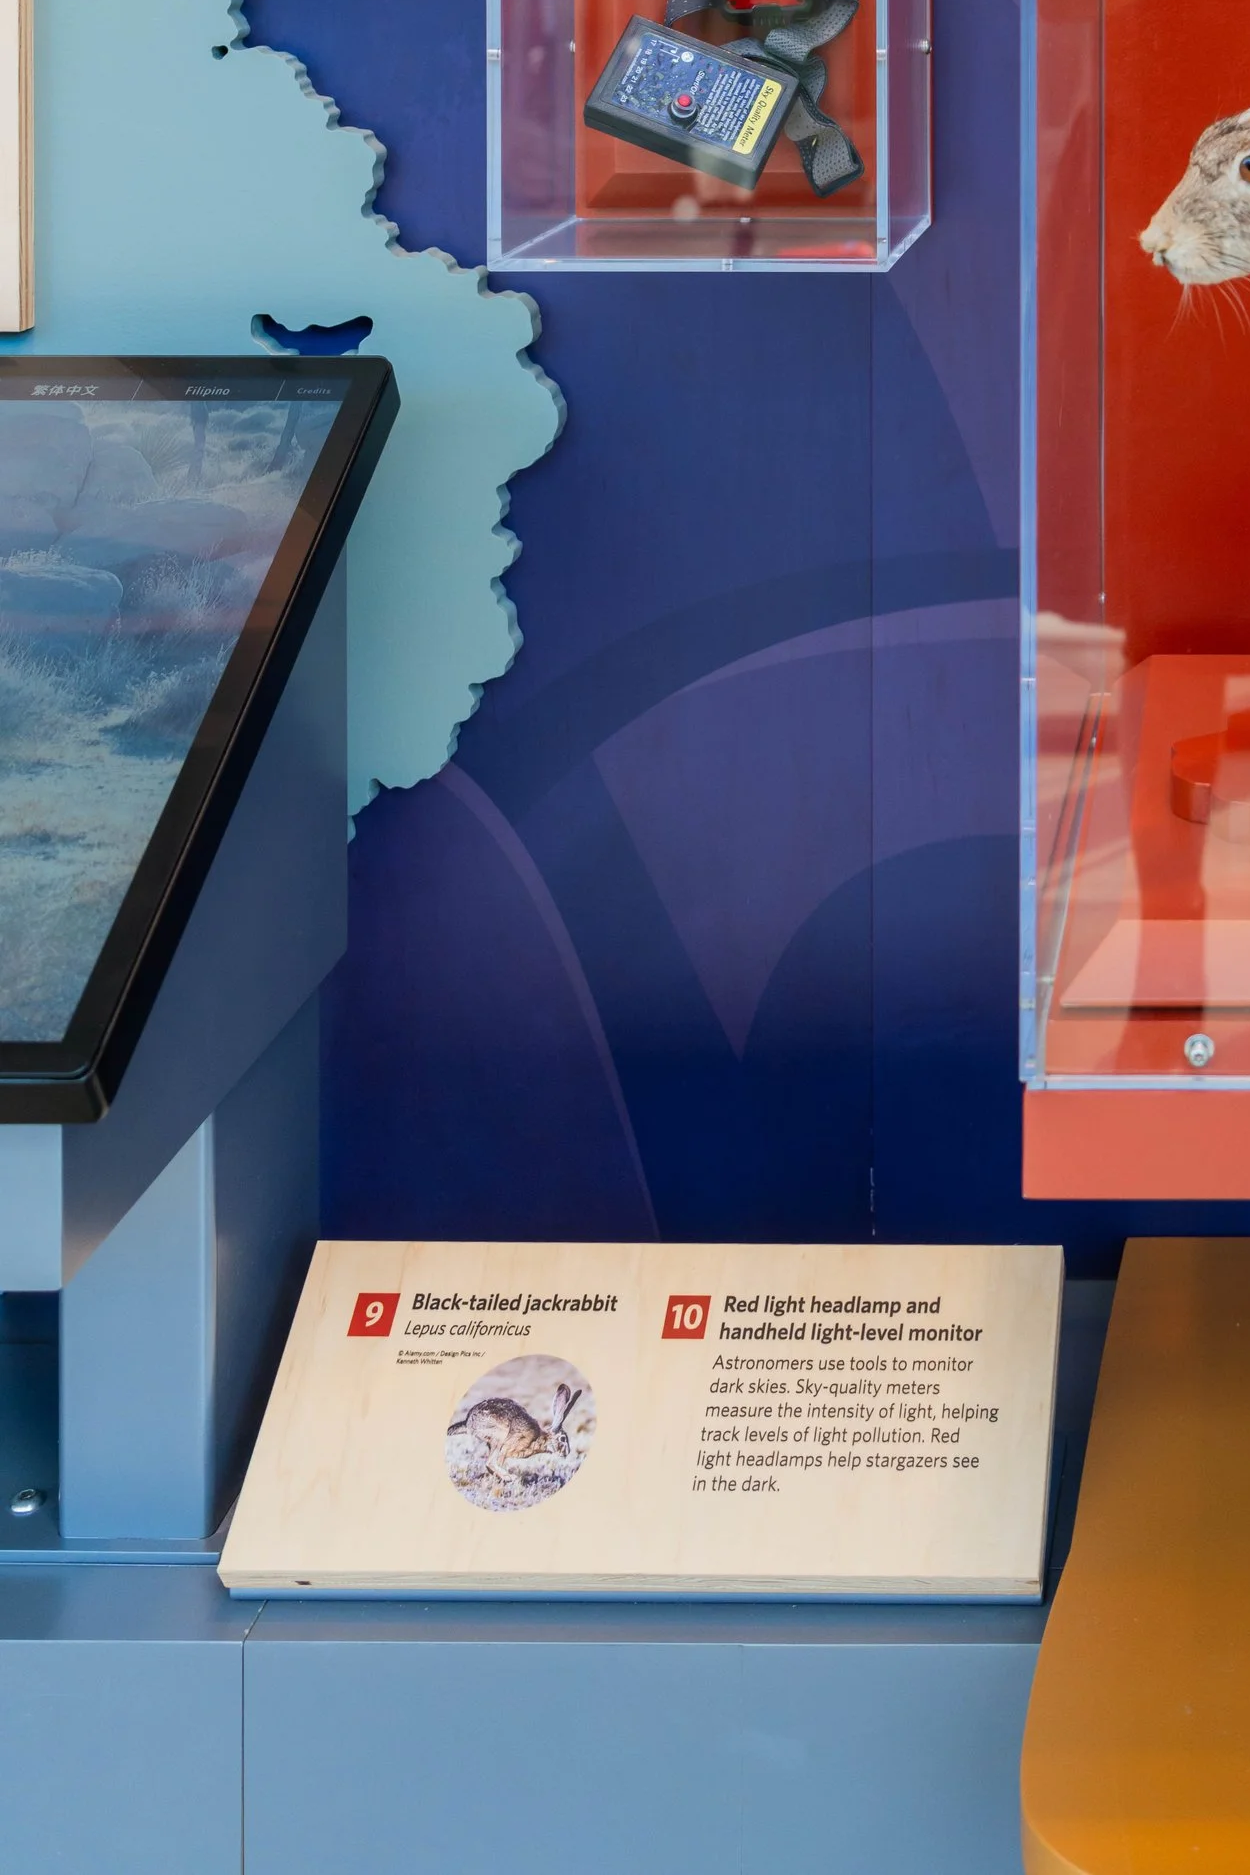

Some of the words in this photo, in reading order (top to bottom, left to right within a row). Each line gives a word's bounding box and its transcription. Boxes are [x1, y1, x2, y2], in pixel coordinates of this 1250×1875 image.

[643, 46, 653, 56] 18
[648, 37, 658, 47] 17
[633, 65, 643, 75] 20
[638, 56, 648, 66] 19
[629, 74, 639, 84] 21
[624, 83, 634, 94] 22
[760, 84, 775, 101] Sky
[618, 93, 629, 104] 23
[748, 100, 768, 126] Quality
[739, 126, 755, 148] Meter
[184, 385, 231, 397] Filipino
[296, 387, 332, 395] Credits
[411, 1292, 523, 1312] Black-tailed
[521, 1293, 619, 1316] jackrabbit
[723, 1294, 760, 1313] Red
[763, 1294, 806, 1317] light
[809, 1295, 902, 1318] headlamp
[906, 1296, 942, 1314] and
[365, 1301, 384, 1327] 9
[669, 1303, 703, 1331] 10
[403, 1320, 447, 1339] Lepus
[449, 1320, 532, 1339] californicus
[719, 1321, 807, 1341] handheld
[810, 1322, 904, 1345] light-level
[908, 1323, 984, 1342] monitor
[711, 1354, 814, 1371] Astronomers
[818, 1359, 845, 1371] use
[849, 1354, 888, 1372] tools
[892, 1356, 908, 1372] to
[911, 1356, 974, 1372] monitor
[709, 1377, 745, 1394] dark
[747, 1377, 790, 1394] skies.
[795, 1378, 882, 1398] Sky-quality
[886, 1380, 940, 1395] meters
[705, 1405, 773, 1418] measure
[777, 1401, 803, 1418] the
[807, 1402, 875, 1422] intensity
[878, 1402, 896, 1419] of
[898, 1402, 936, 1423] light,
[941, 1402, 1000, 1423] helping
[701, 1425, 741, 1442] track
[744, 1425, 789, 1443] levels
[793, 1425, 811, 1443] of
[813, 1426, 848, 1447] light
[851, 1426, 925, 1446] pollution.
[930, 1427, 961, 1444] Red
[696, 1449, 732, 1470] light
[735, 1449, 823, 1471] headlamps
[827, 1450, 862, 1471] help
[865, 1452, 948, 1472] stargazers
[952, 1456, 980, 1469] see
[692, 1475, 707, 1492] in
[711, 1475, 737, 1492] the
[741, 1475, 780, 1492] dark.
